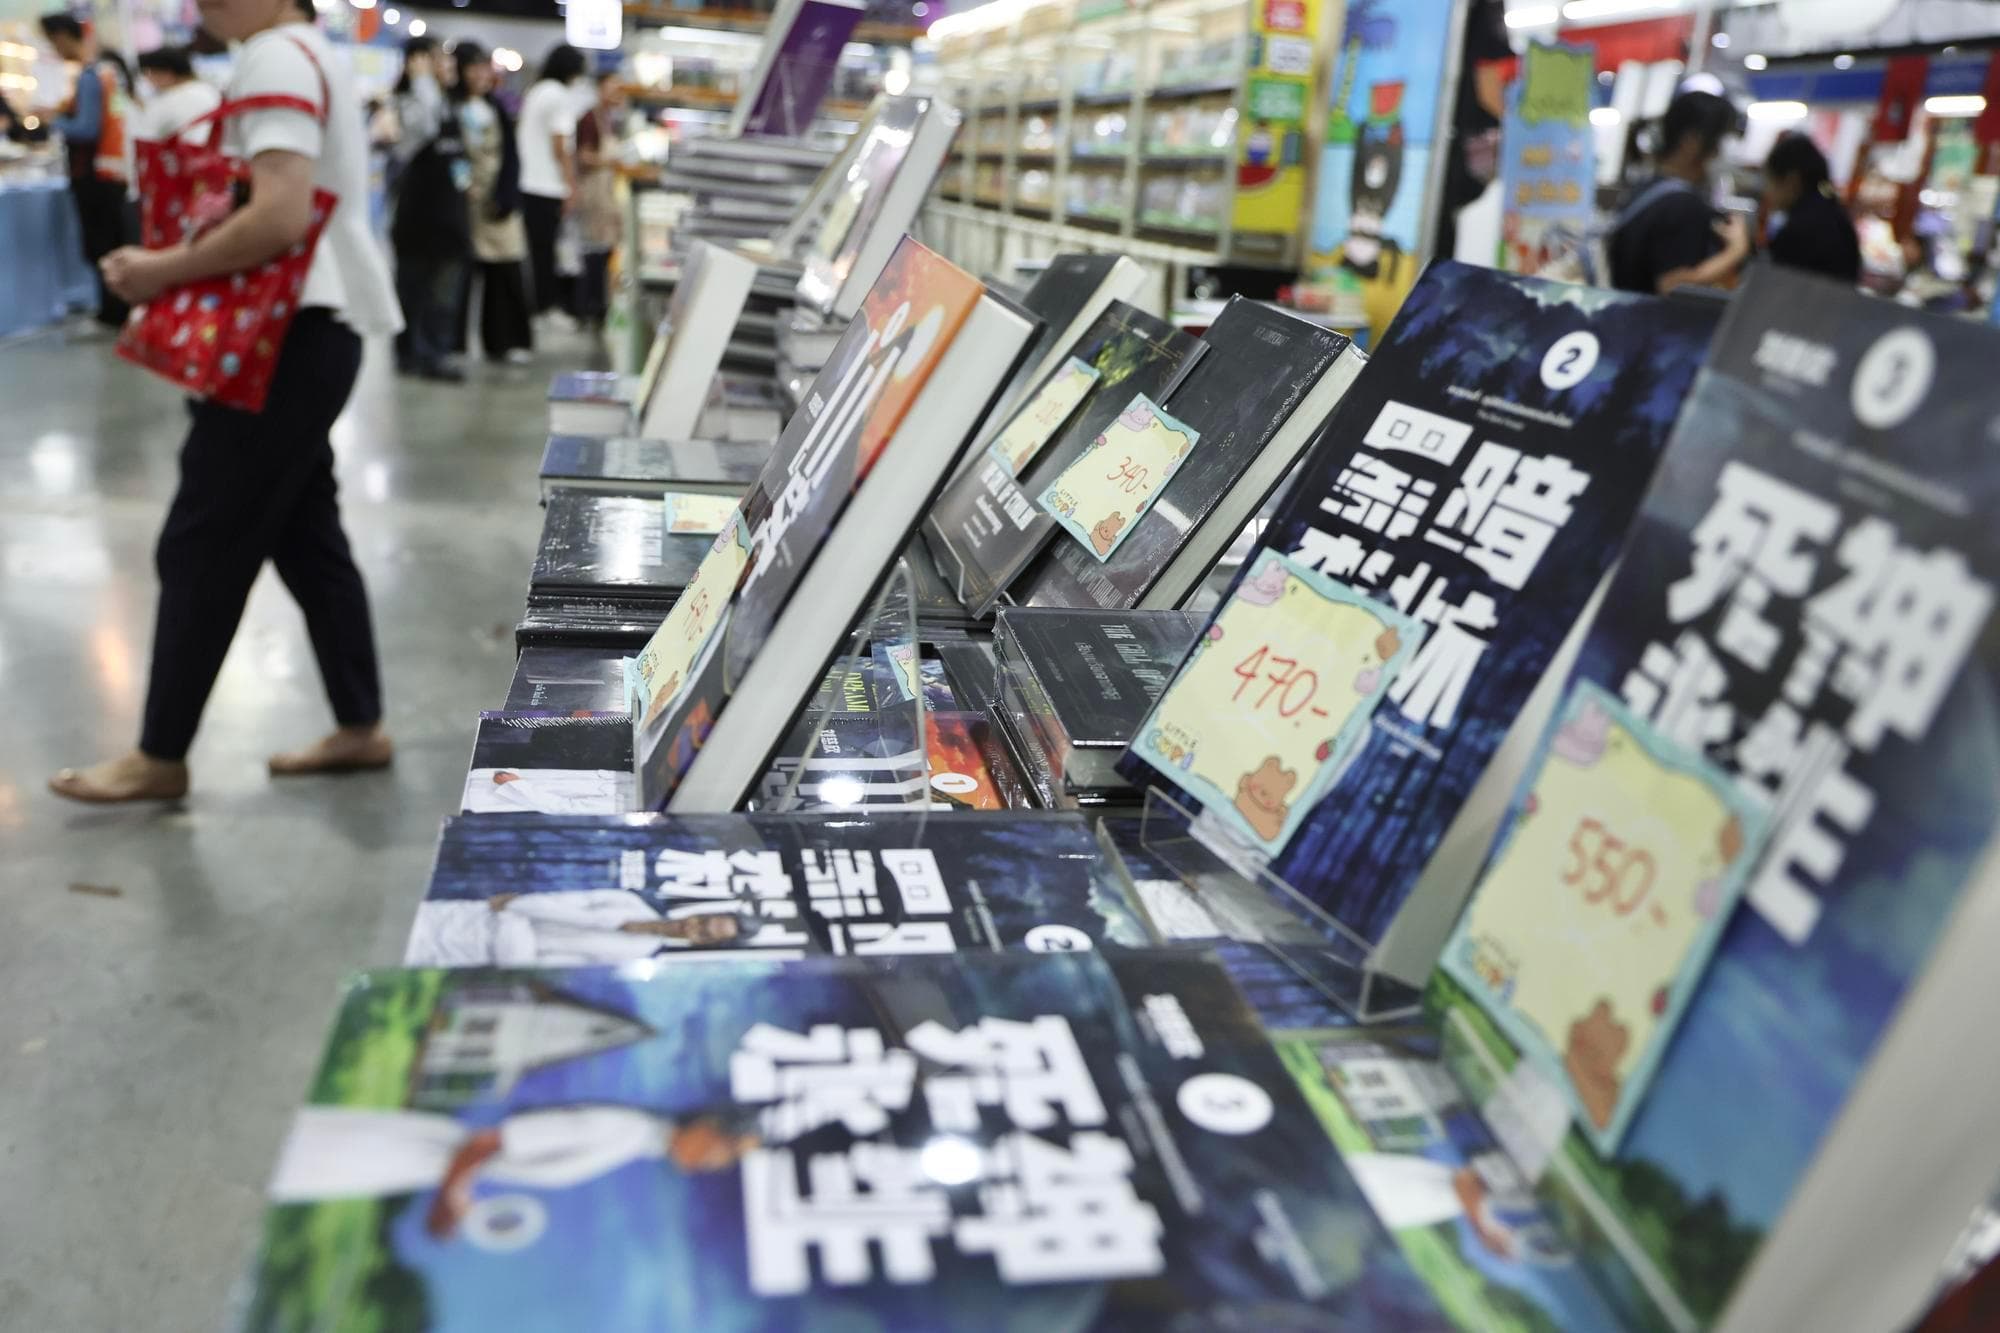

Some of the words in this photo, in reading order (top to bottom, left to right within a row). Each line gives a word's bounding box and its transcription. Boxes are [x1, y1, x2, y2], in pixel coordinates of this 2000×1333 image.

[1555, 347, 1583, 375] 2
[1100, 624, 1136, 640] THE
[1114, 643, 1153, 665] CALL
